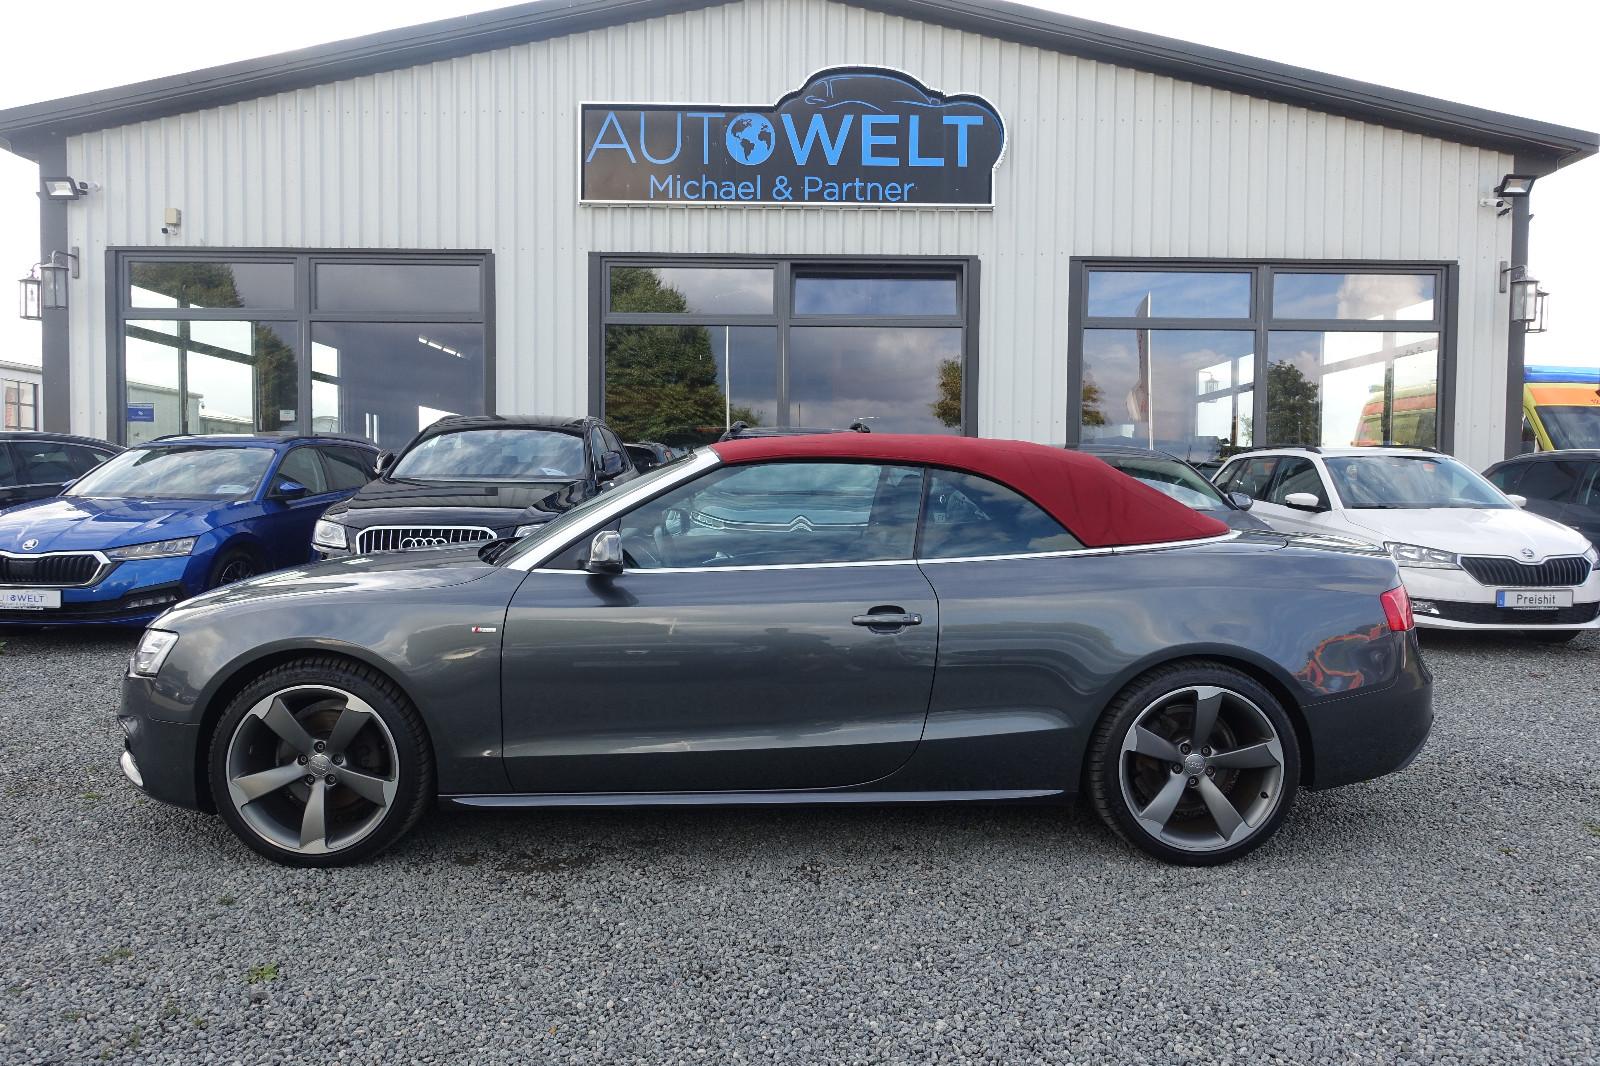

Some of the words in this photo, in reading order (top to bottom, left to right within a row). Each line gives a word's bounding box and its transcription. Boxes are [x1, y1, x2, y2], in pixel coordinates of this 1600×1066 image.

[586, 112, 985, 168] AUTOWELT
[649, 174, 761, 201] Michael
[772, 175, 793, 201] &
[803, 176, 914, 202] Partner
[1516, 594, 1556, 605] Preishit
